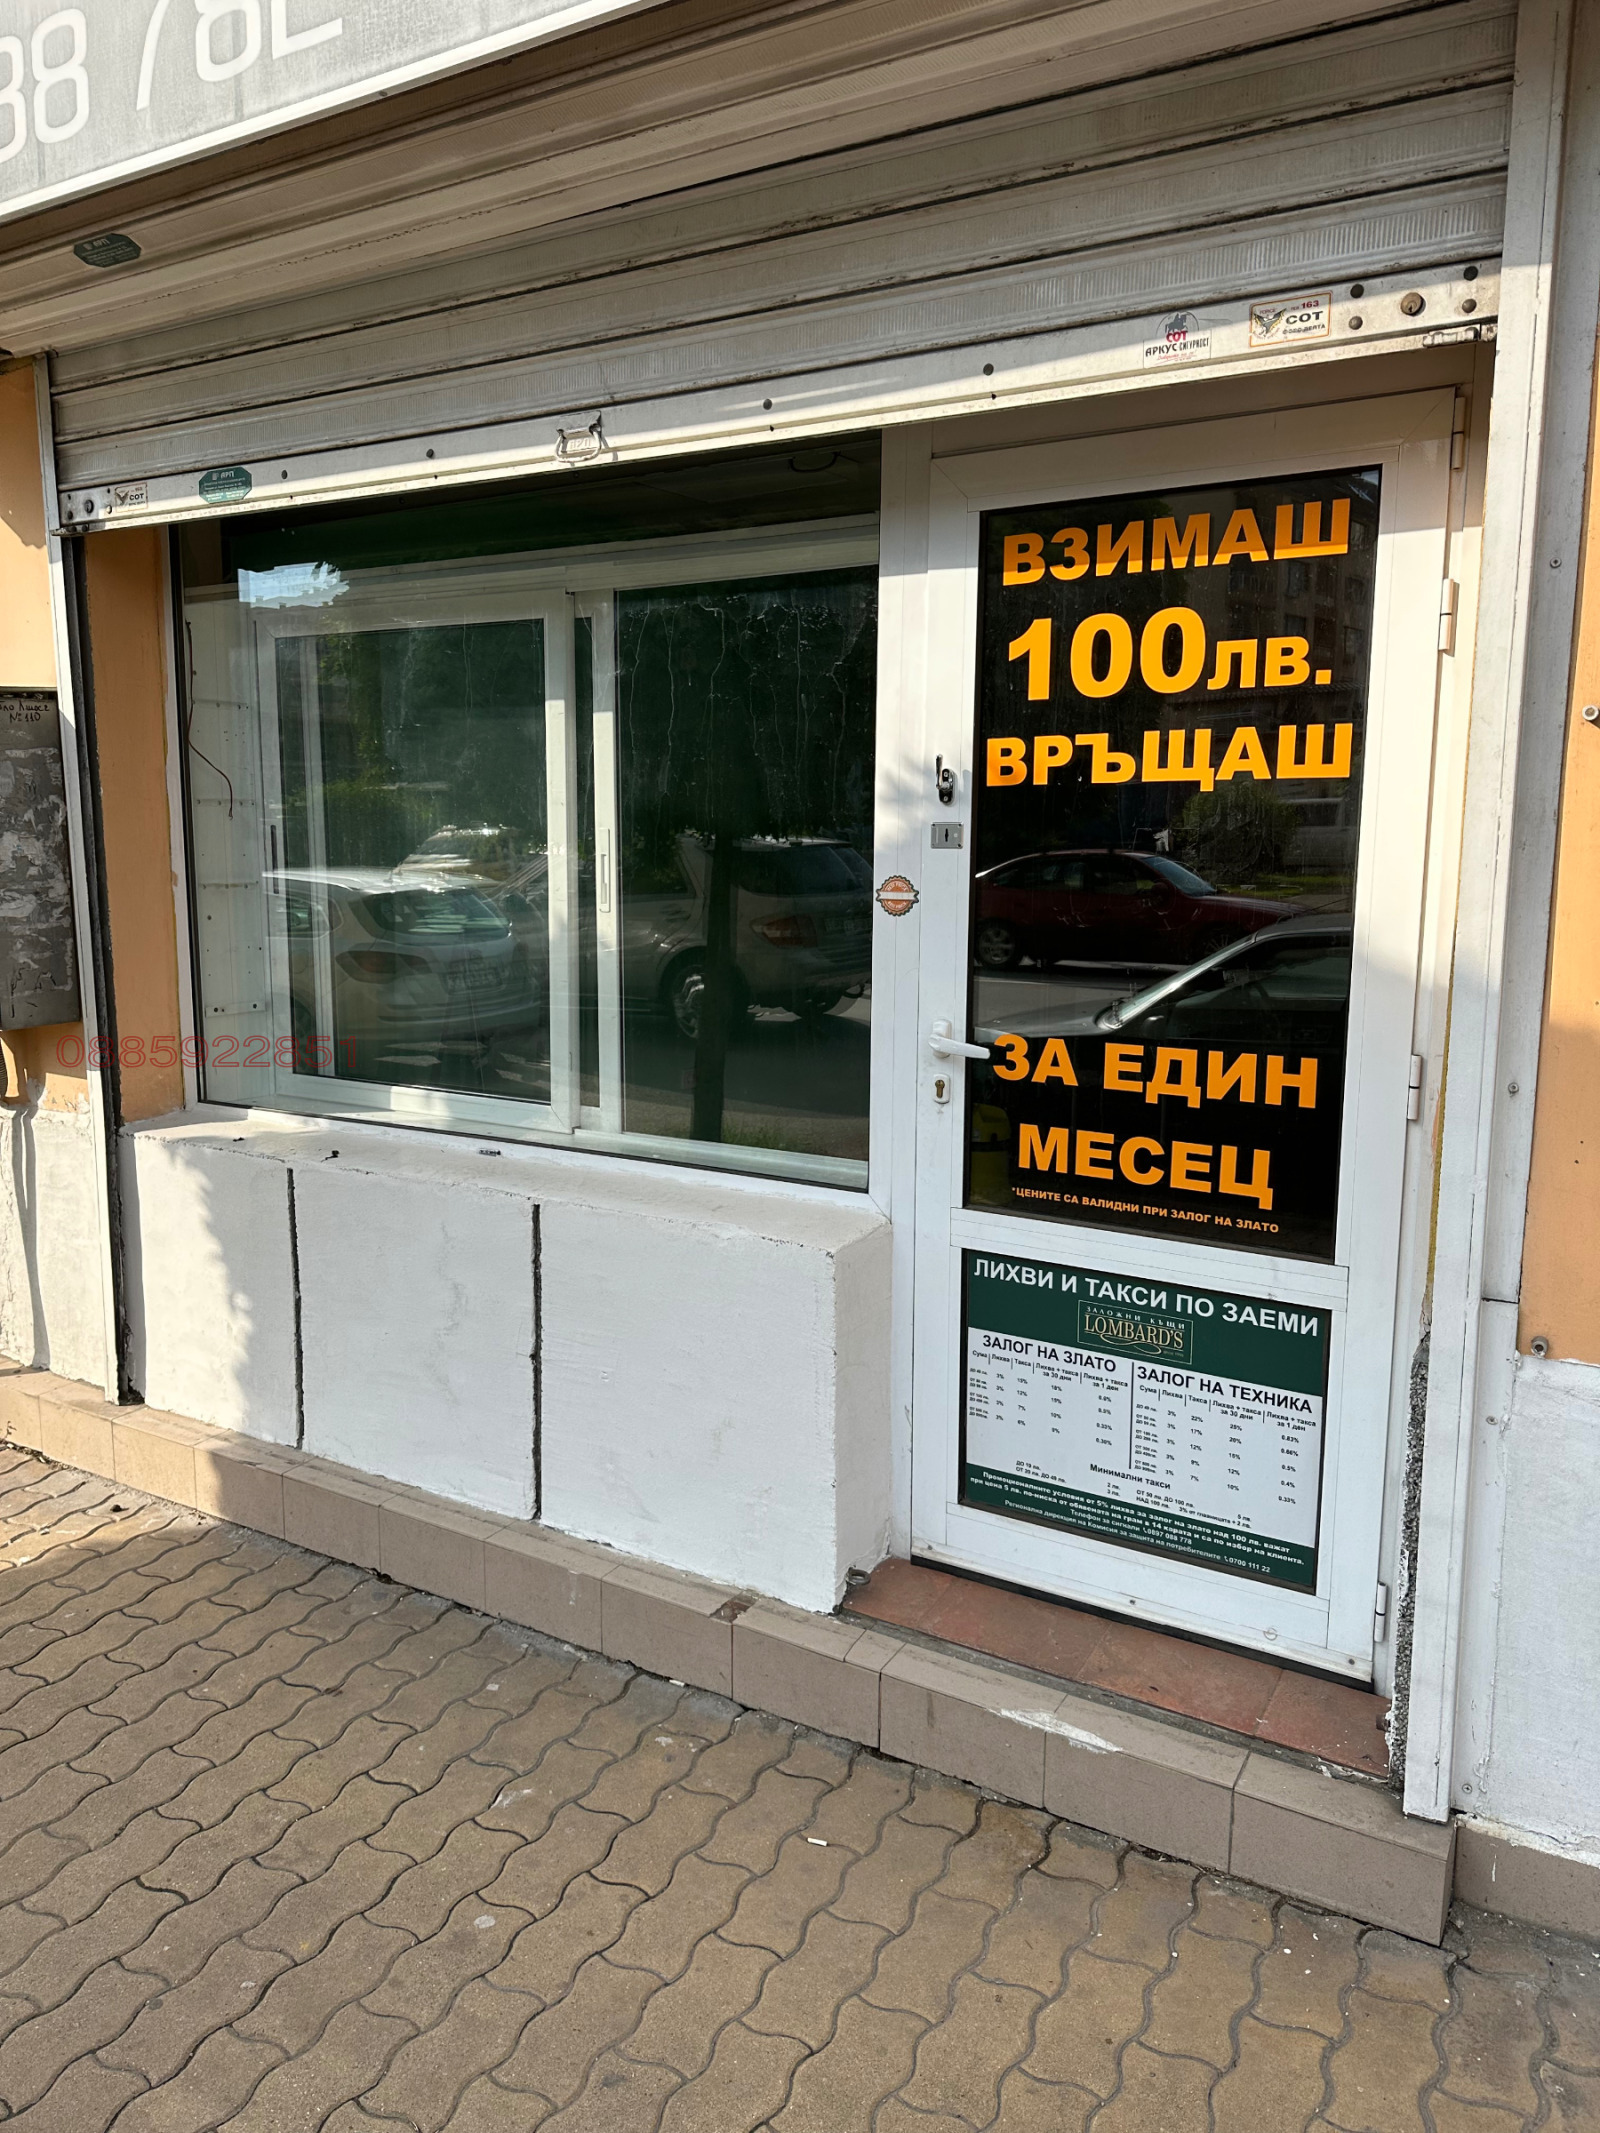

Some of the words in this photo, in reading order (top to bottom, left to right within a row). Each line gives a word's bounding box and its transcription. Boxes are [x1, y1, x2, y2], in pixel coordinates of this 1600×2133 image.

[1286, 311, 1324, 325] СОТ
[1301, 300, 1319, 309] 163
[1145, 343, 1177, 357] АРКУС
[1166, 331, 1188, 343] СОТ
[129, 493, 144, 501] СОТ
[1003, 498, 1351, 587] ВЗИМАШ
[1008, 606, 1332, 701] 100лв.
[986, 723, 1353, 792] ВРЪЩАШ
[992, 1034, 1079, 1087] ЗА
[1103, 1042, 1319, 1109] ЕДИН
[1018, 1123, 1273, 1211] МЕСЕЦ
[1063, 1193, 1079, 1205] СА
[1081, 1196, 1140, 1214] ВАЛИДНИ
[1142, 1204, 1168, 1218] ПРИ
[1170, 1208, 1212, 1223] ЗАЛОГ
[1214, 1215, 1233, 1227] НА
[1235, 1218, 1280, 1234] ЗЛАТО
[973, 1259, 1053, 1289] ЛИХВИ
[1060, 1273, 1077, 1294] И
[1083, 1278, 1168, 1309] ТАКСИ
[1175, 1292, 1215, 1319] ПО
[1221, 1301, 1319, 1336] ЗАЕМИ
[1084, 1314, 1184, 1348] LOMBARD'S
[1086, 1306, 1140, 1320] ЗАЛОЖНИ
[1149, 1317, 1184, 1330] КЪЩИ
[982, 1335, 1033, 1355] ЗАЛОГ
[1037, 1344, 1059, 1361] НА
[1063, 1350, 1116, 1372] ЗЛАТО
[1136, 1366, 1195, 1388] ЗАЛОГ
[1199, 1377, 1225, 1395] НА
[1228, 1384, 1313, 1412] ТЕХНИКА
[1139, 1383, 1157, 1395] Сума
[1161, 1390, 1183, 1398] Лихва
[1187, 1395, 1207, 1403] Такса
[1089, 1464, 1143, 1482] Минимални
[1144, 1478, 1170, 1489] такси
[1010, 1486, 1021, 1494] лв.
[1023, 1490, 1056, 1502] по-ниска
[1122, 1514, 1143, 1525] грам
[1151, 1521, 1162, 1529] 14
[1213, 1537, 1224, 1545] по
[1225, 1540, 1252, 1552] избор
[1253, 1547, 1265, 1555] на
[1052, 1489, 1084, 1502] условия
[1085, 1497, 1095, 1505] от
[1096, 1499, 1108, 1508] 5%
[1109, 1504, 1134, 1514] лихва
[1136, 1510, 1146, 1518] за
[1148, 1514, 1172, 1523] залог
[1174, 1519, 1184, 1527] на
[1186, 1523, 1211, 1533] злато
[1212, 1529, 1229, 1539] над
[1230, 1532, 1246, 1543] 100
[1247, 1538, 1261, 1546] лв.
[1263, 1542, 1290, 1552] важат
[1070, 1509, 1101, 1521] Телефон
[1111, 1520, 1140, 1530] сигнали
[1179, 1536, 1192, 1545] 778
[1228, 1556, 1246, 1567] 0700
[1247, 1561, 1259, 1570] 111
[1261, 1564, 1270, 1573] 22
